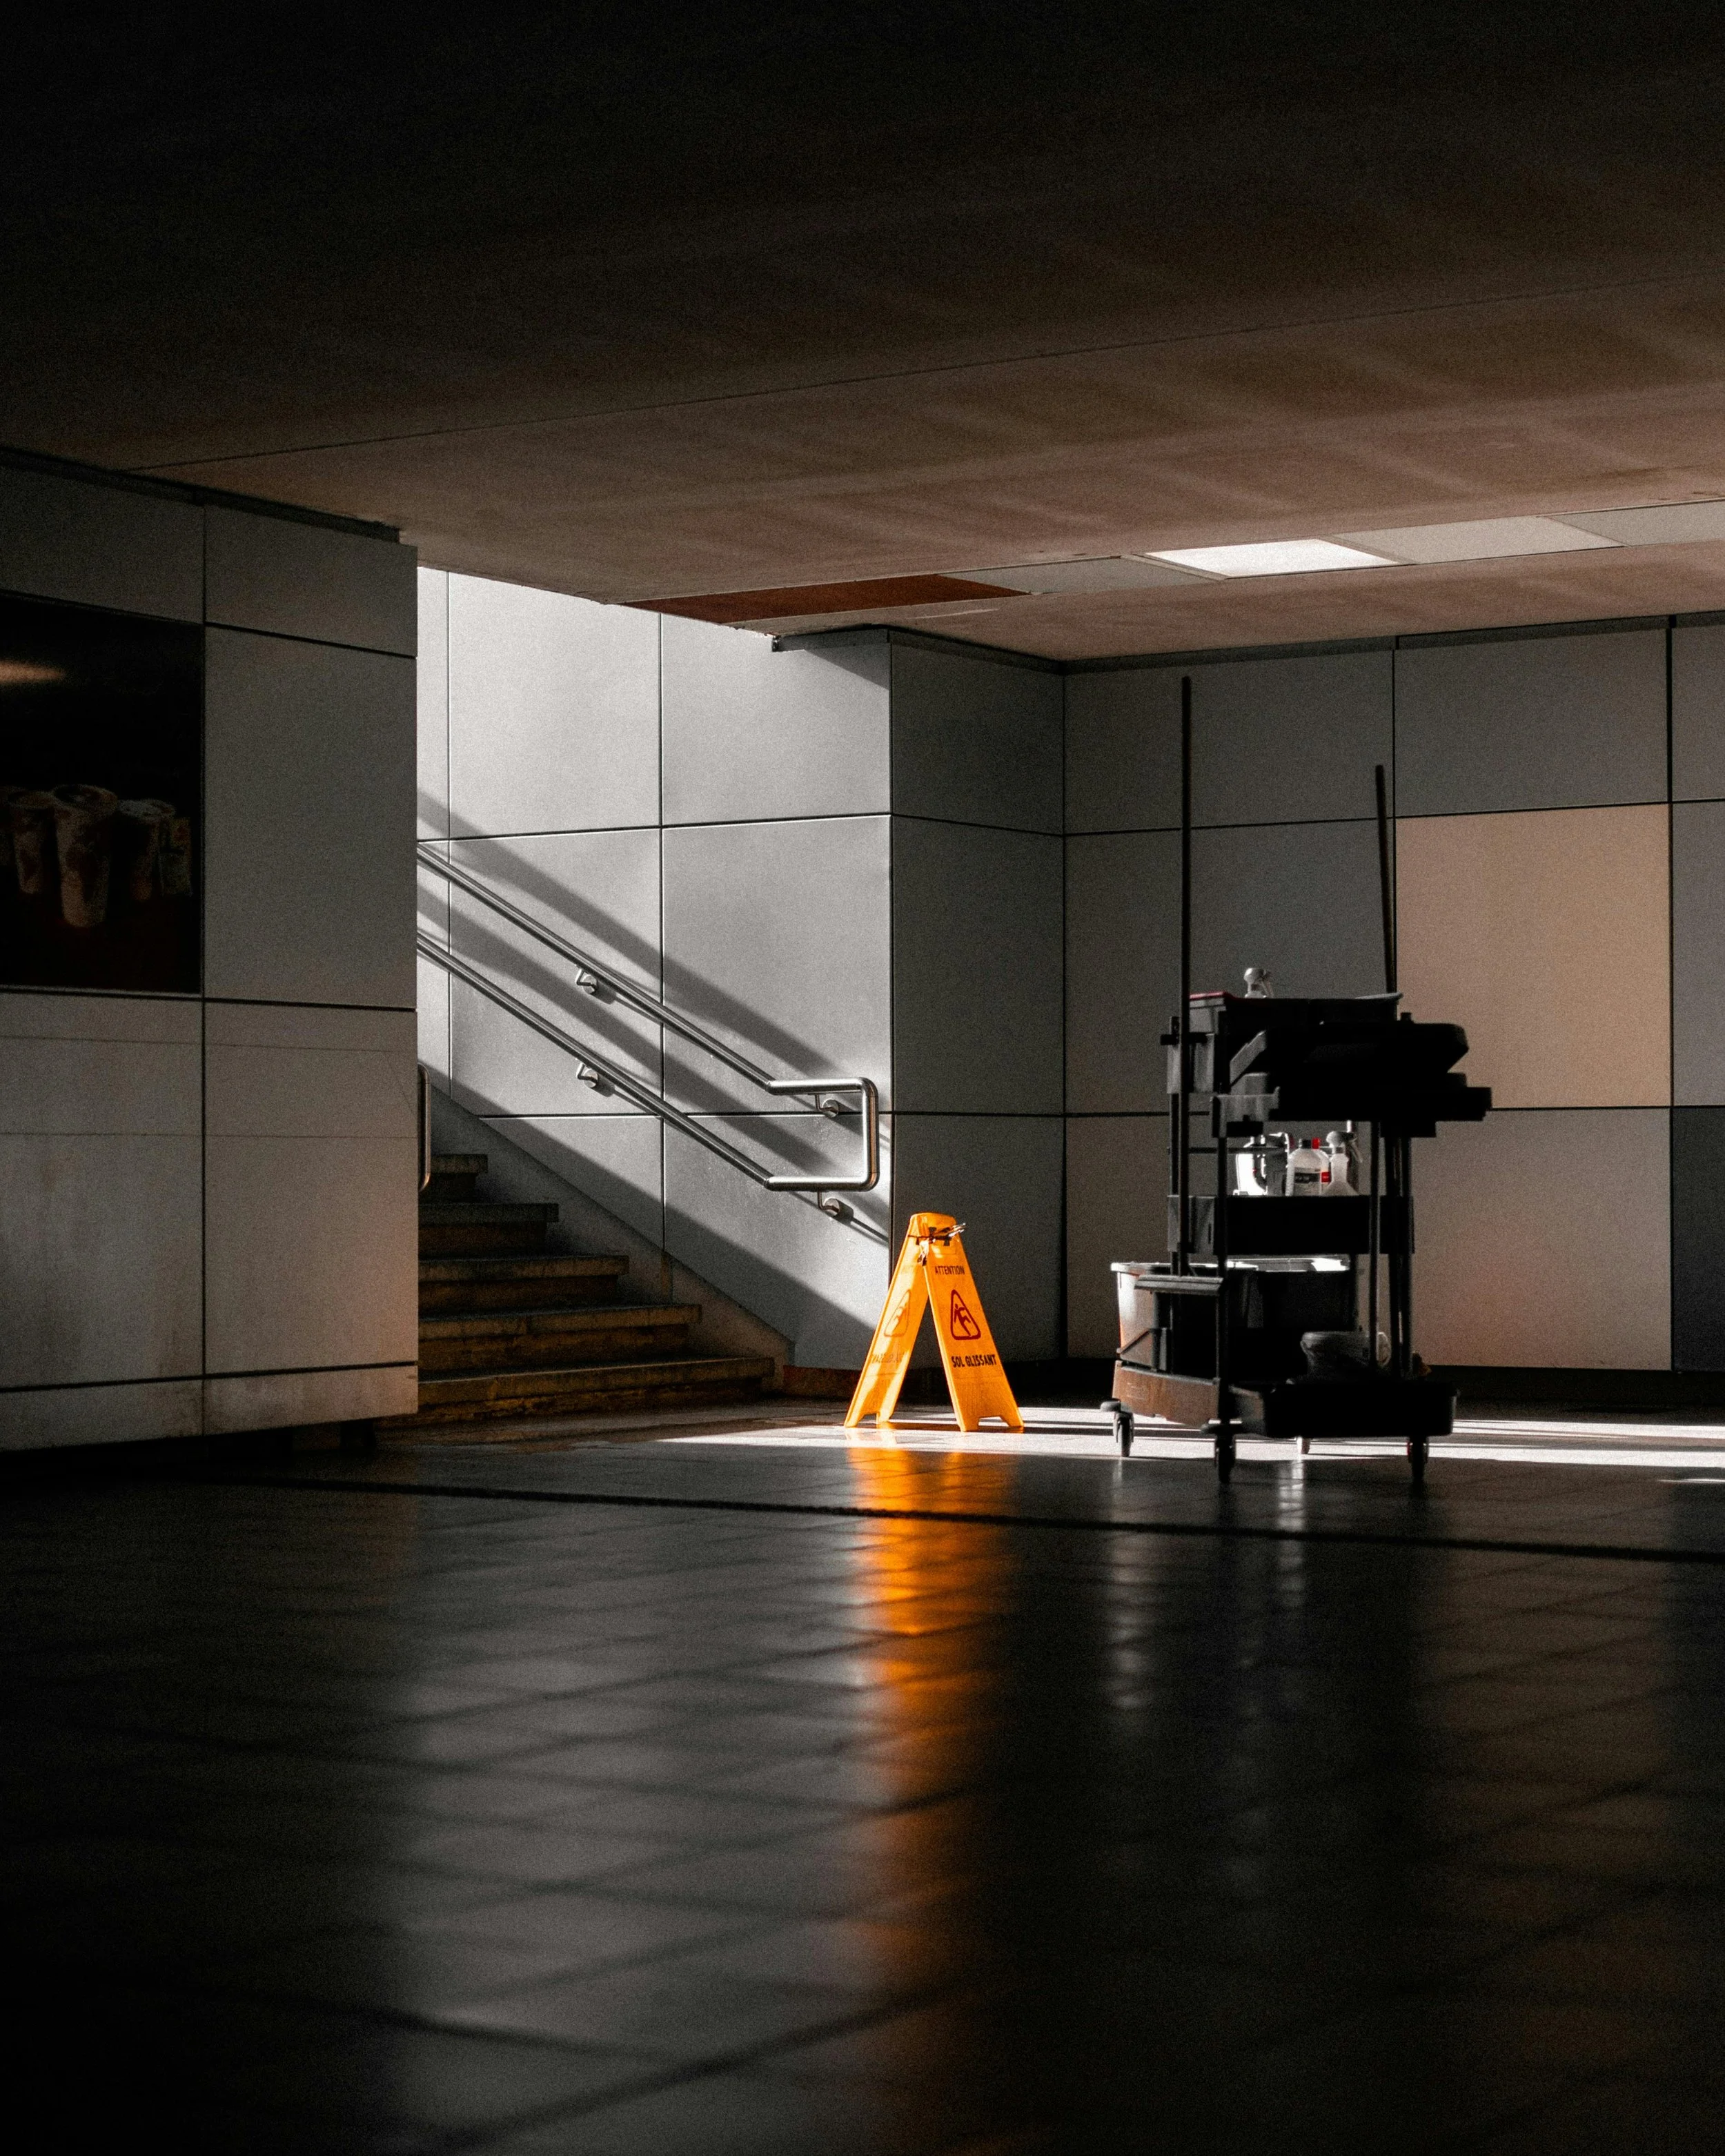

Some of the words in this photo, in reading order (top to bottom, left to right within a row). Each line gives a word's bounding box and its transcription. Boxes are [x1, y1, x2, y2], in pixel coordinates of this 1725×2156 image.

[934, 1265, 965, 1275] ATTENTION
[952, 1356, 965, 1368] SOL
[966, 1354, 997, 1367] GLISSANT
